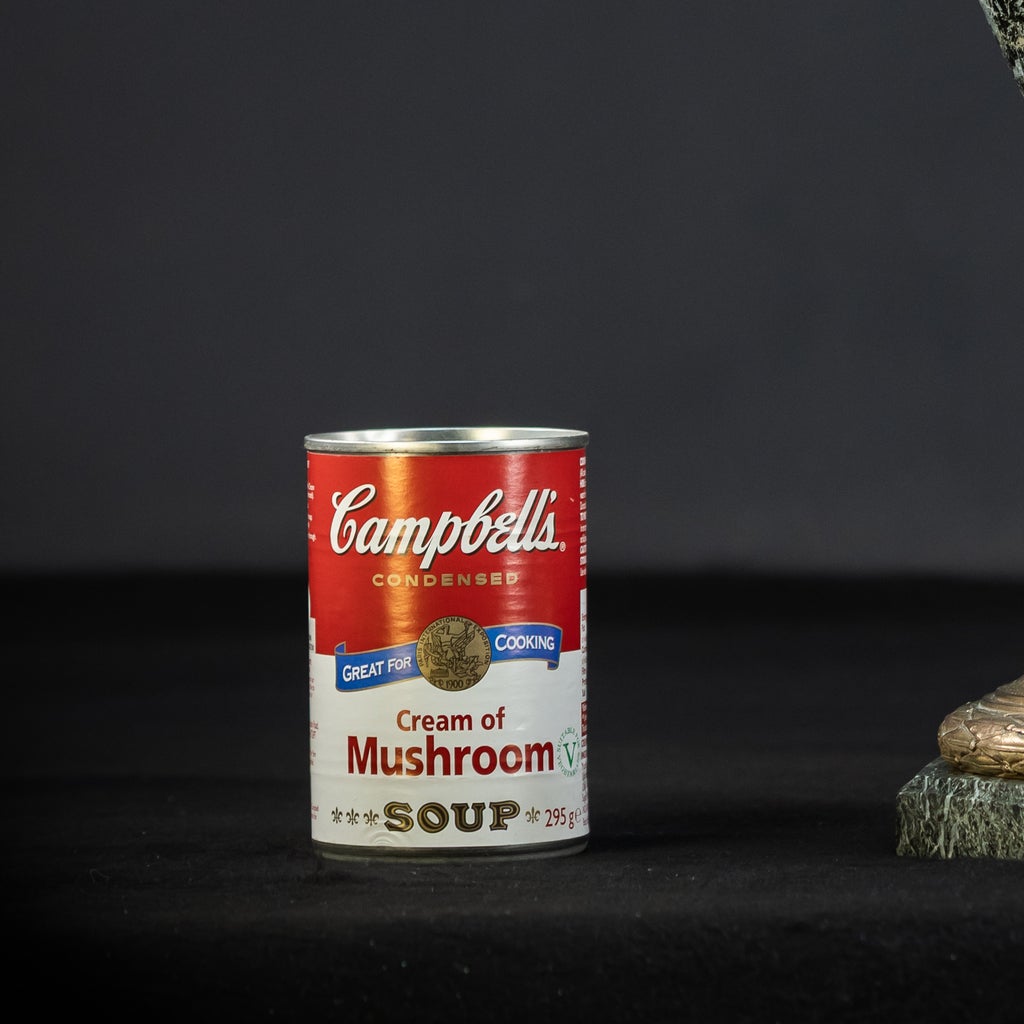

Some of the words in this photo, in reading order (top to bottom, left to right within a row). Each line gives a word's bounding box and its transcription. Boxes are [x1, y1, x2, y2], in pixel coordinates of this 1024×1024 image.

[330, 483, 559, 570] Campbell's
[372, 572, 519, 587] CONDENSED
[342, 661, 384, 682] GREAT
[387, 656, 412, 673] FOR
[494, 634, 555, 651] COOKING
[446, 679, 464, 689] 1900
[396, 709, 473, 732] Cream
[480, 706, 506, 730] of
[347, 735, 555, 776] Mushroom
[562, 741, 577, 768] V
[383, 800, 521, 834] SOUP
